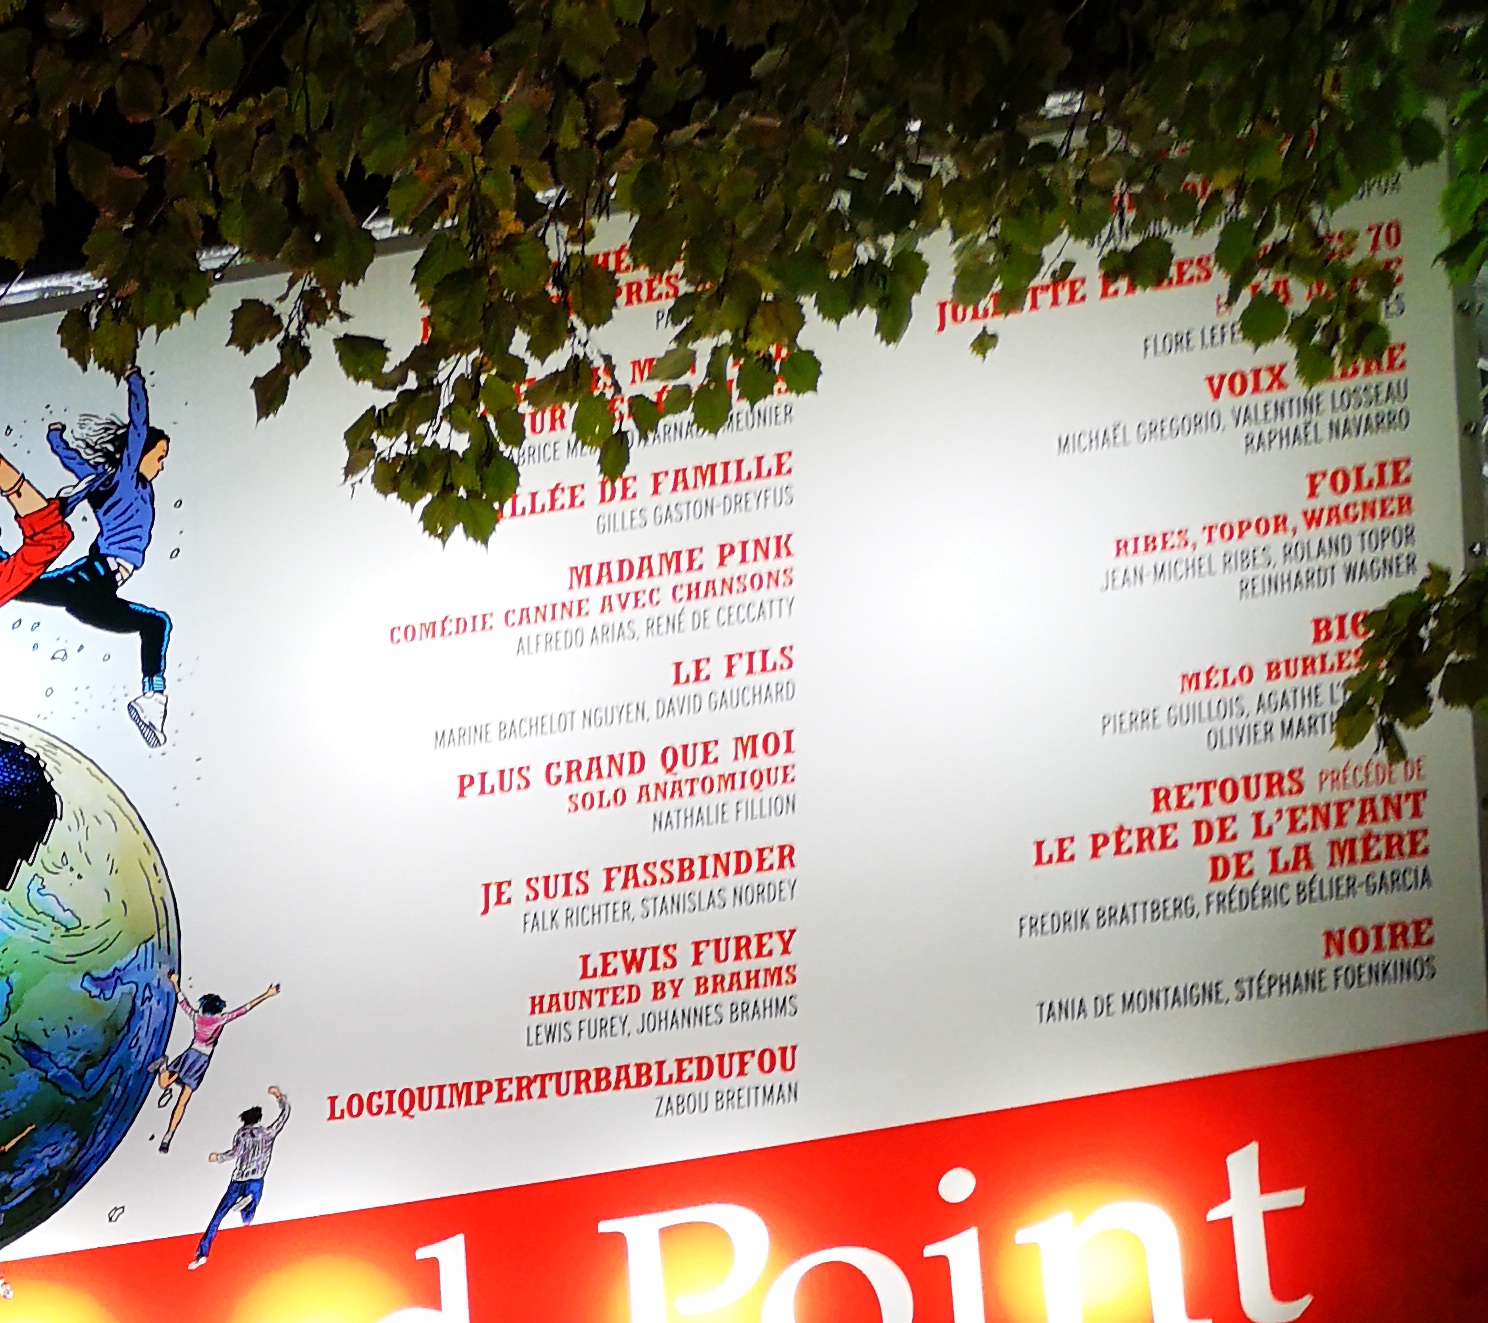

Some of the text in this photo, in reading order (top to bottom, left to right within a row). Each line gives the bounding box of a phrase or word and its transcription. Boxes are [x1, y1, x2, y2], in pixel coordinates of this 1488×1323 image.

[1205, 363, 1288, 399] VOIX
[600, 475, 636, 504] DE
[652, 451, 792, 496] FAMILLE
[1308, 457, 1411, 499] FOLIE
[569, 534, 792, 589] MADAME PINK
[673, 645, 793, 685] LE FILS
[459, 730, 793, 798] PLUS GRAND QUE MOI
[1153, 767, 1304, 813] RETOURS
[1035, 793, 1427, 866] LE PÈRE DE L'ENFANT
[1209, 828, 1429, 882] DE LA MÈRE
[481, 844, 795, 915] JE SUIS FASSBINDER
[580, 929, 795, 980] LEWIS FUREY
[1324, 918, 1434, 959] NOIRE
[530, 964, 796, 1015] HAUNTED BY BRAHMS
[656, 1082, 797, 1117] ZABOU BREITMAN
